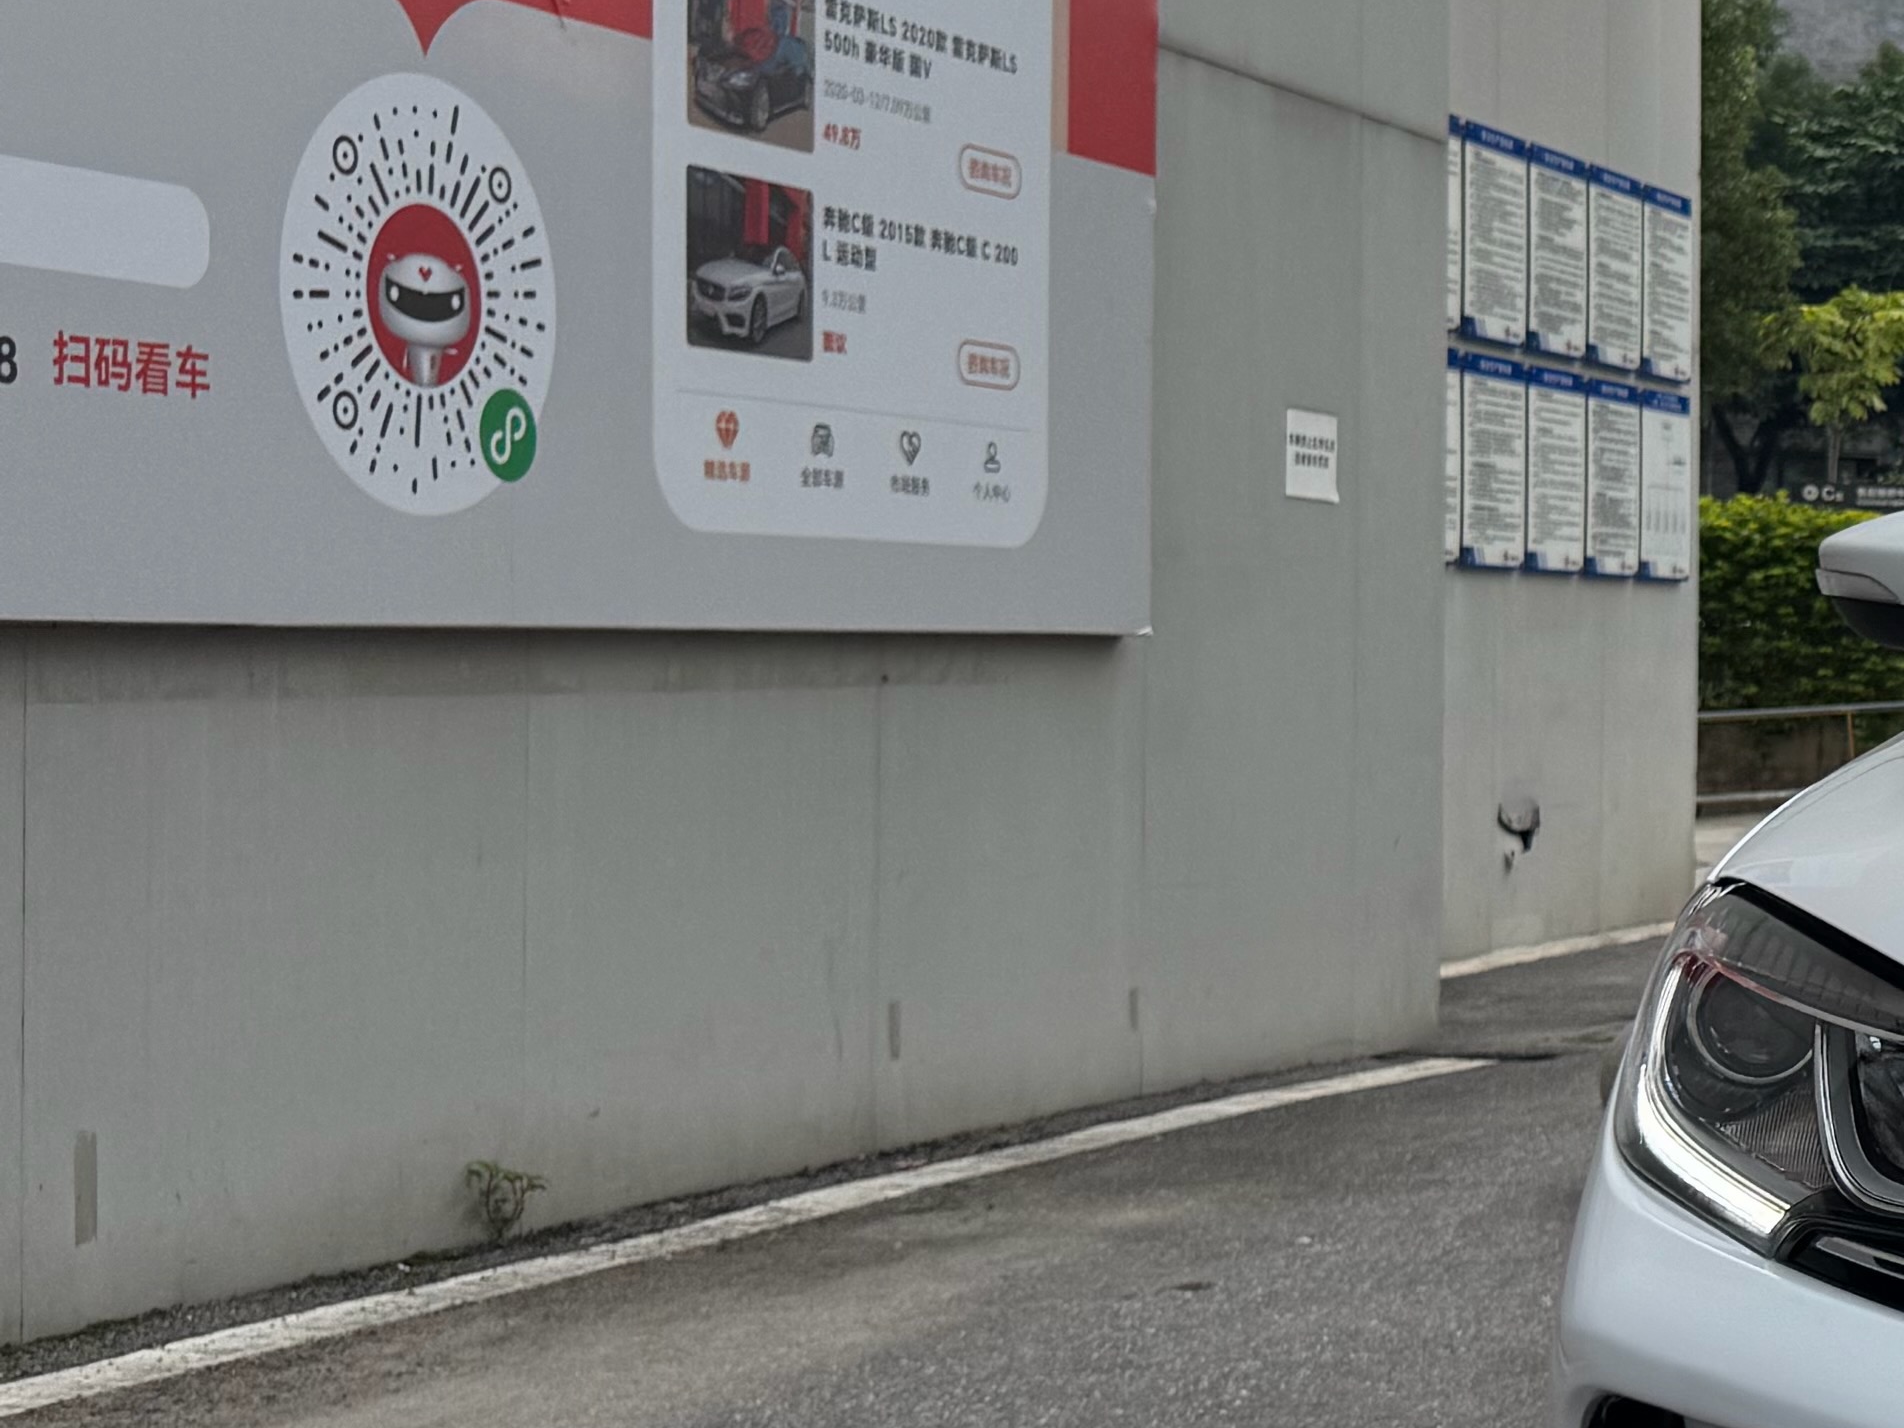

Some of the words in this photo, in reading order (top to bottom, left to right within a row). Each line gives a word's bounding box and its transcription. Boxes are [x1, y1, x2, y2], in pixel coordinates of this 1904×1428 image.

[824, 30, 860, 61] 500h
[901, 20, 948, 54] 2020款
[823, 205, 875, 238] 奔驰C级
[930, 224, 977, 257] 奔驰C级
[994, 242, 1019, 266] 200
[53, 329, 211, 399] 扫码看车
[972, 481, 1012, 504] 个人中心
